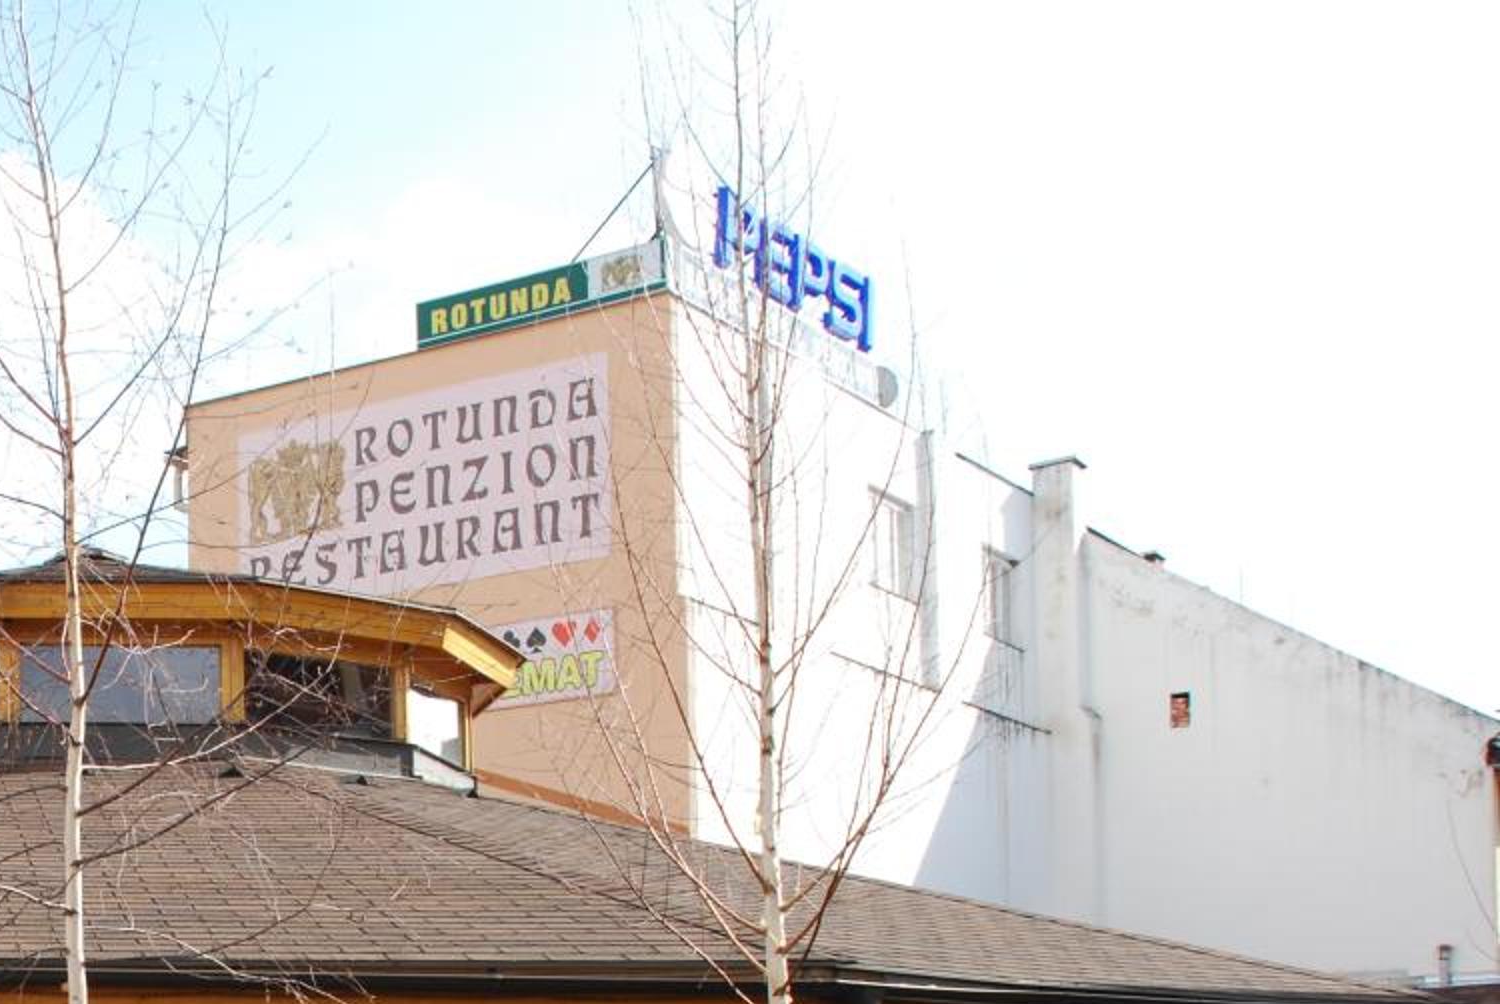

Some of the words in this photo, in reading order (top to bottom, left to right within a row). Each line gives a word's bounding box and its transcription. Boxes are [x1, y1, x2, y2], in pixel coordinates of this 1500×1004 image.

[430, 277, 572, 335] ROTUNDA
[713, 185, 874, 353] PEPSI
[355, 376, 598, 467] ROTUNDA
[355, 435, 597, 523] PENZION
